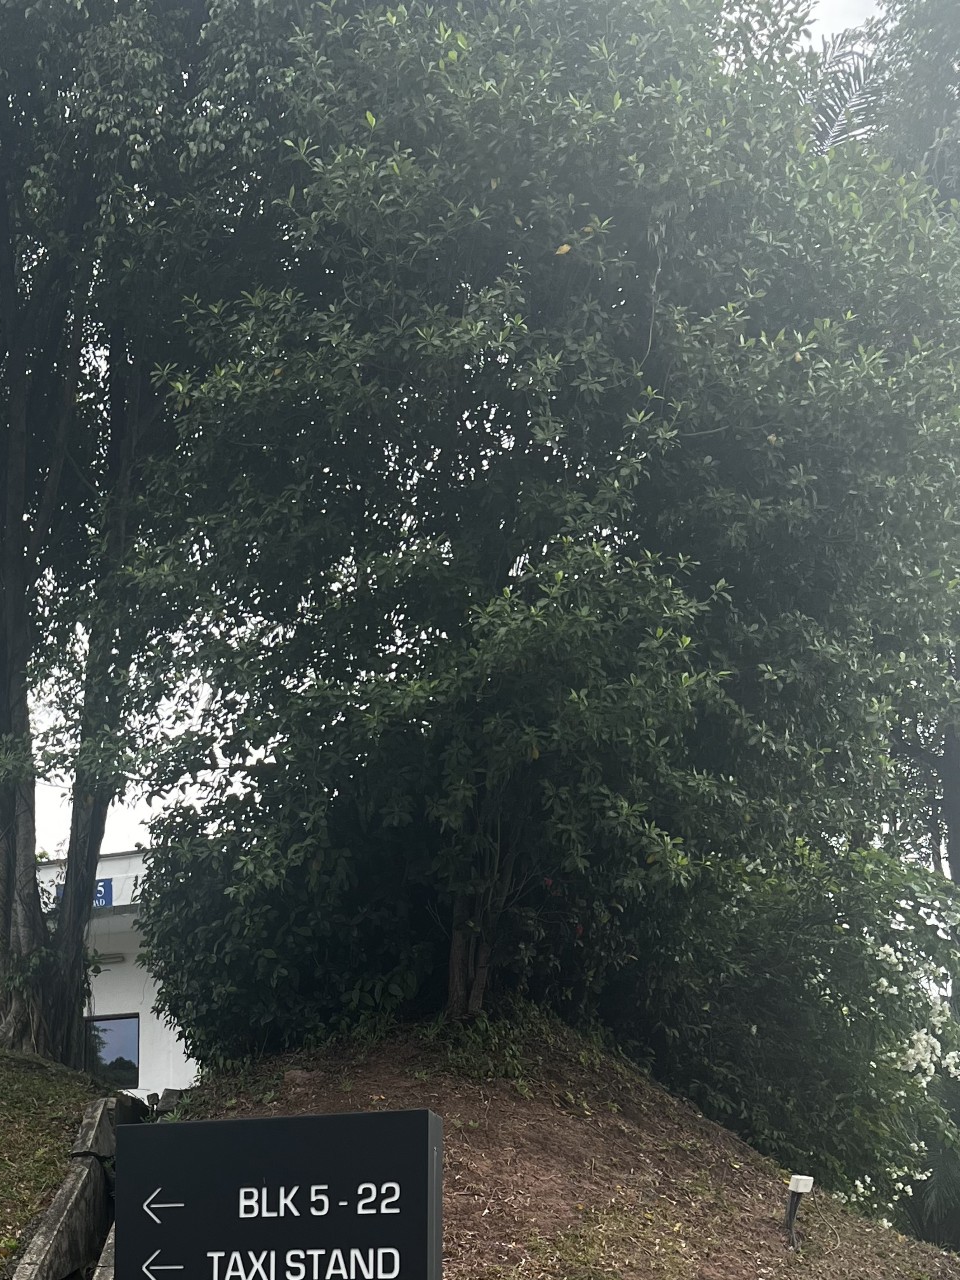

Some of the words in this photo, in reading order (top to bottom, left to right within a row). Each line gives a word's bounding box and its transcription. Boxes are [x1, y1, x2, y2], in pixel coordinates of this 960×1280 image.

[239, 1186, 301, 1218] BLK
[309, 1184, 330, 1216] 5
[356, 1181, 401, 1215] 22
[285, 1247, 400, 1280] STAND
